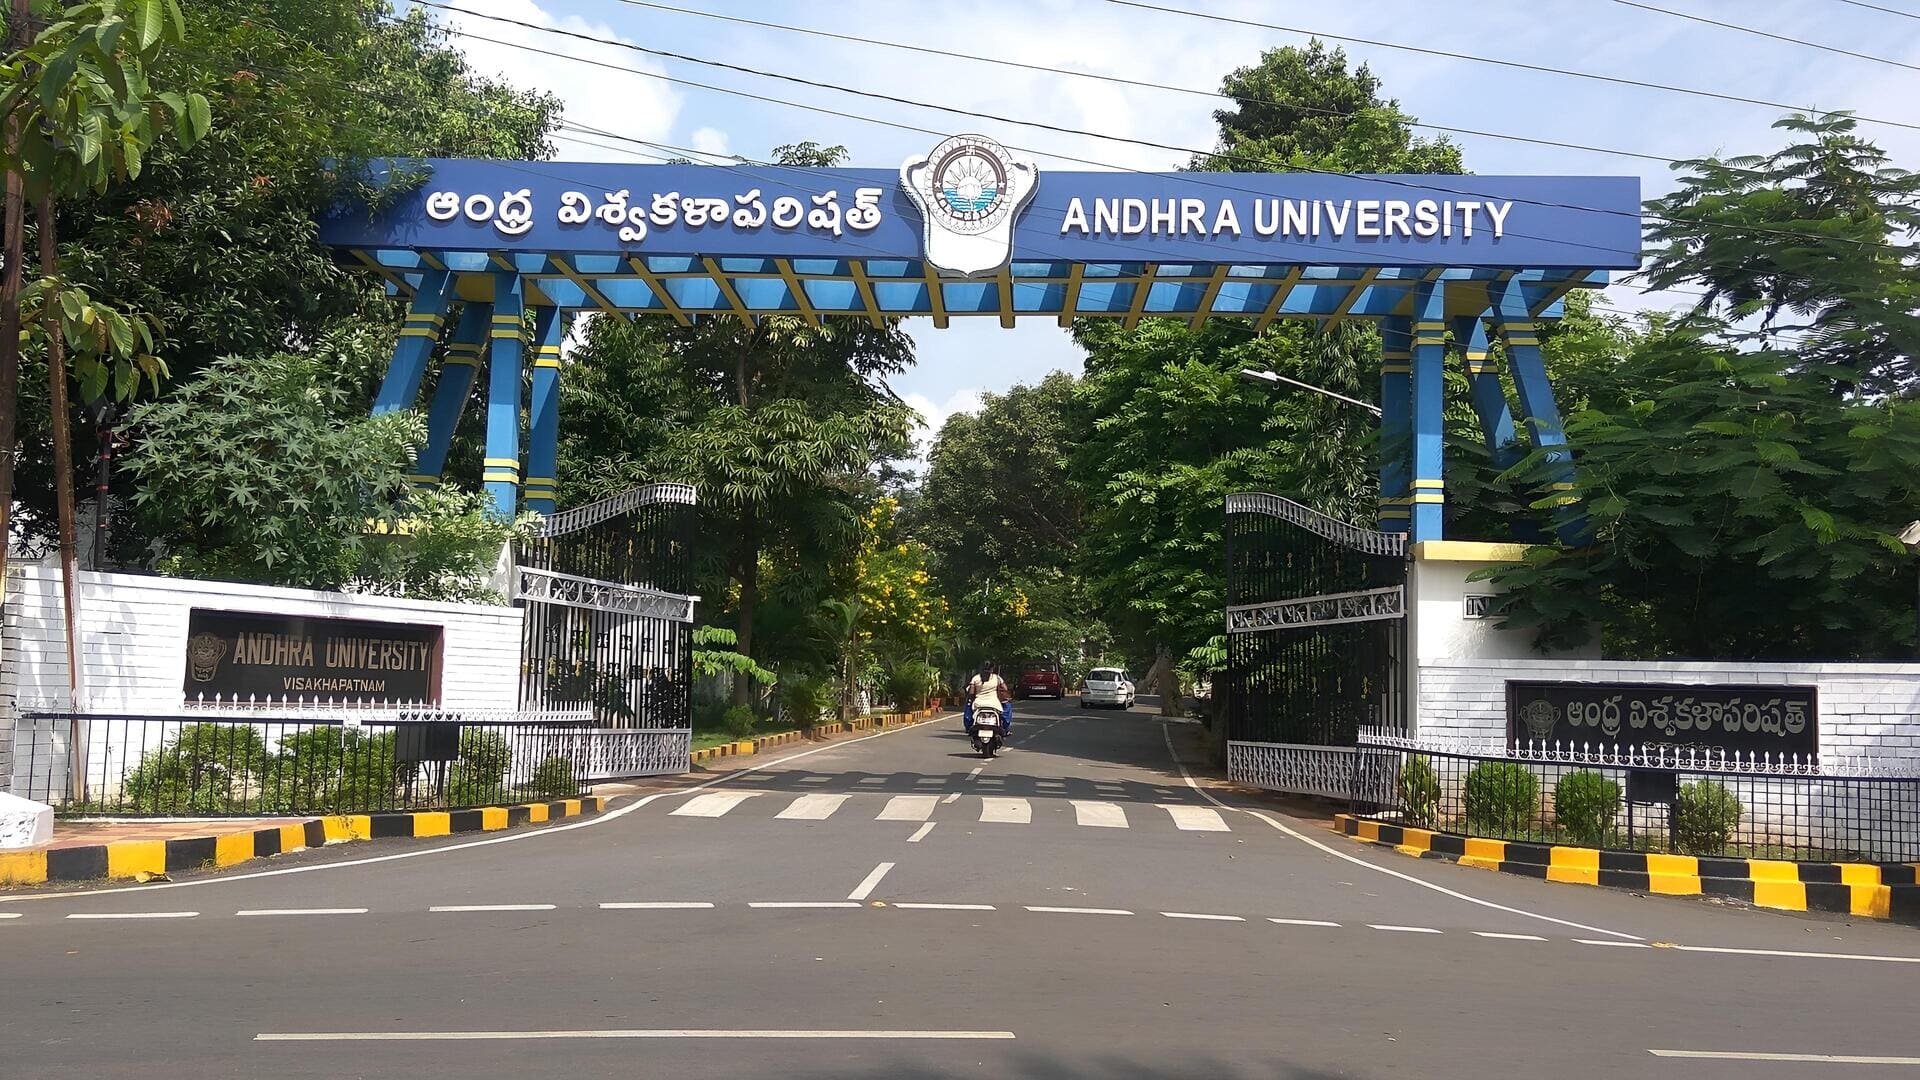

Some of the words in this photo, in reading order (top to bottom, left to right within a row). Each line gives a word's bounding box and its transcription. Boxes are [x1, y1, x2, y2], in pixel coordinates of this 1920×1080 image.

[426, 188, 534, 235] ఆంధ్ర
[1061, 197, 1241, 235] ANDHRA
[1253, 199, 1513, 239] UNIVERSITY
[233, 632, 314, 667] ANDHRA
[326, 637, 429, 671] UNIVERSITY
[283, 677, 386, 692] VISAKHAPATNAM
[1567, 696, 1622, 739] ఆంధ్ర
